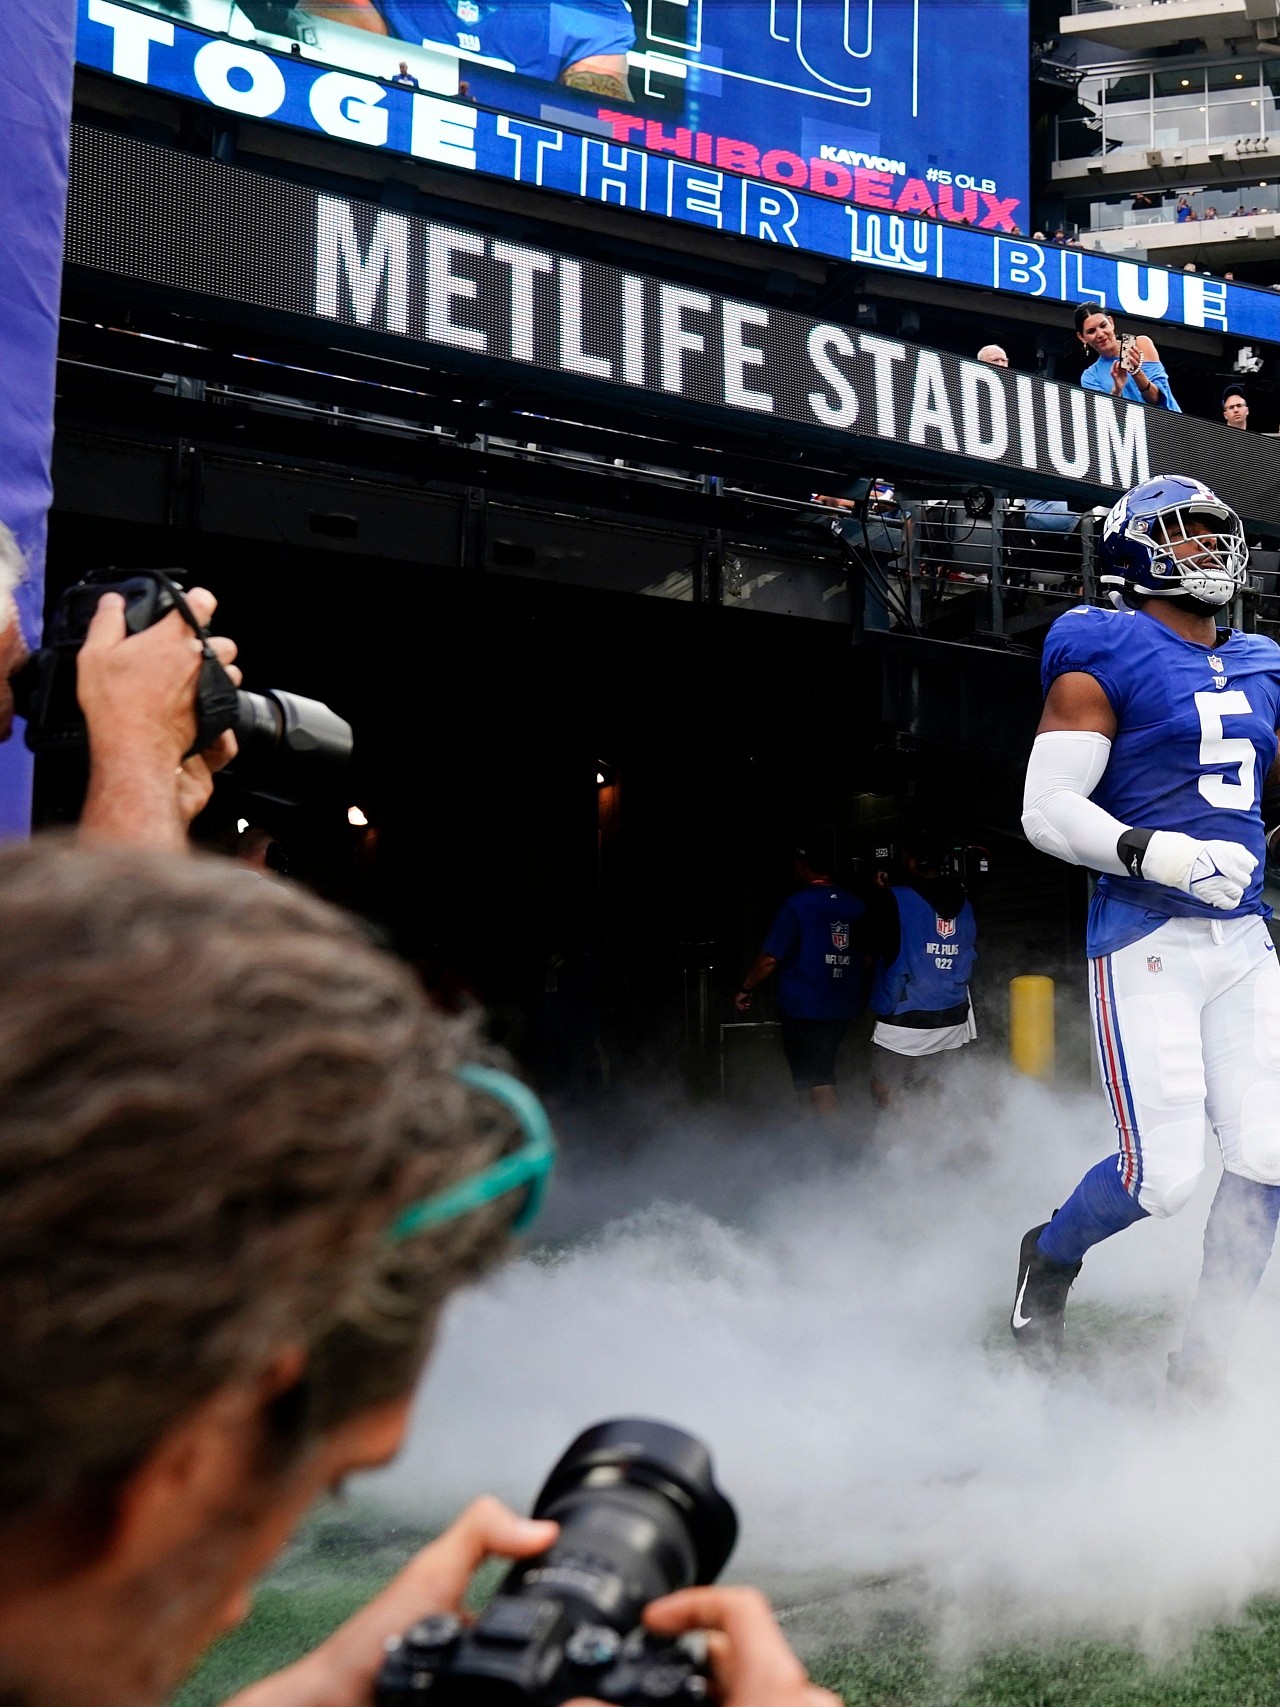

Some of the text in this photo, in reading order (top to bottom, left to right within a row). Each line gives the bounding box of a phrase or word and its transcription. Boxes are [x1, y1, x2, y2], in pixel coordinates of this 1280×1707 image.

[88, 0, 799, 247] TOGETHER
[598, 109, 1020, 234] THIBODEAUX
[820, 145, 906, 176] KAYVON
[925, 167, 997, 195] #5 OLB
[994, 235, 1228, 333] BLUE
[313, 194, 1151, 491] METLIFE STADIUM
[1194, 690, 1257, 812] 5
[926, 942, 941, 955] NFL
